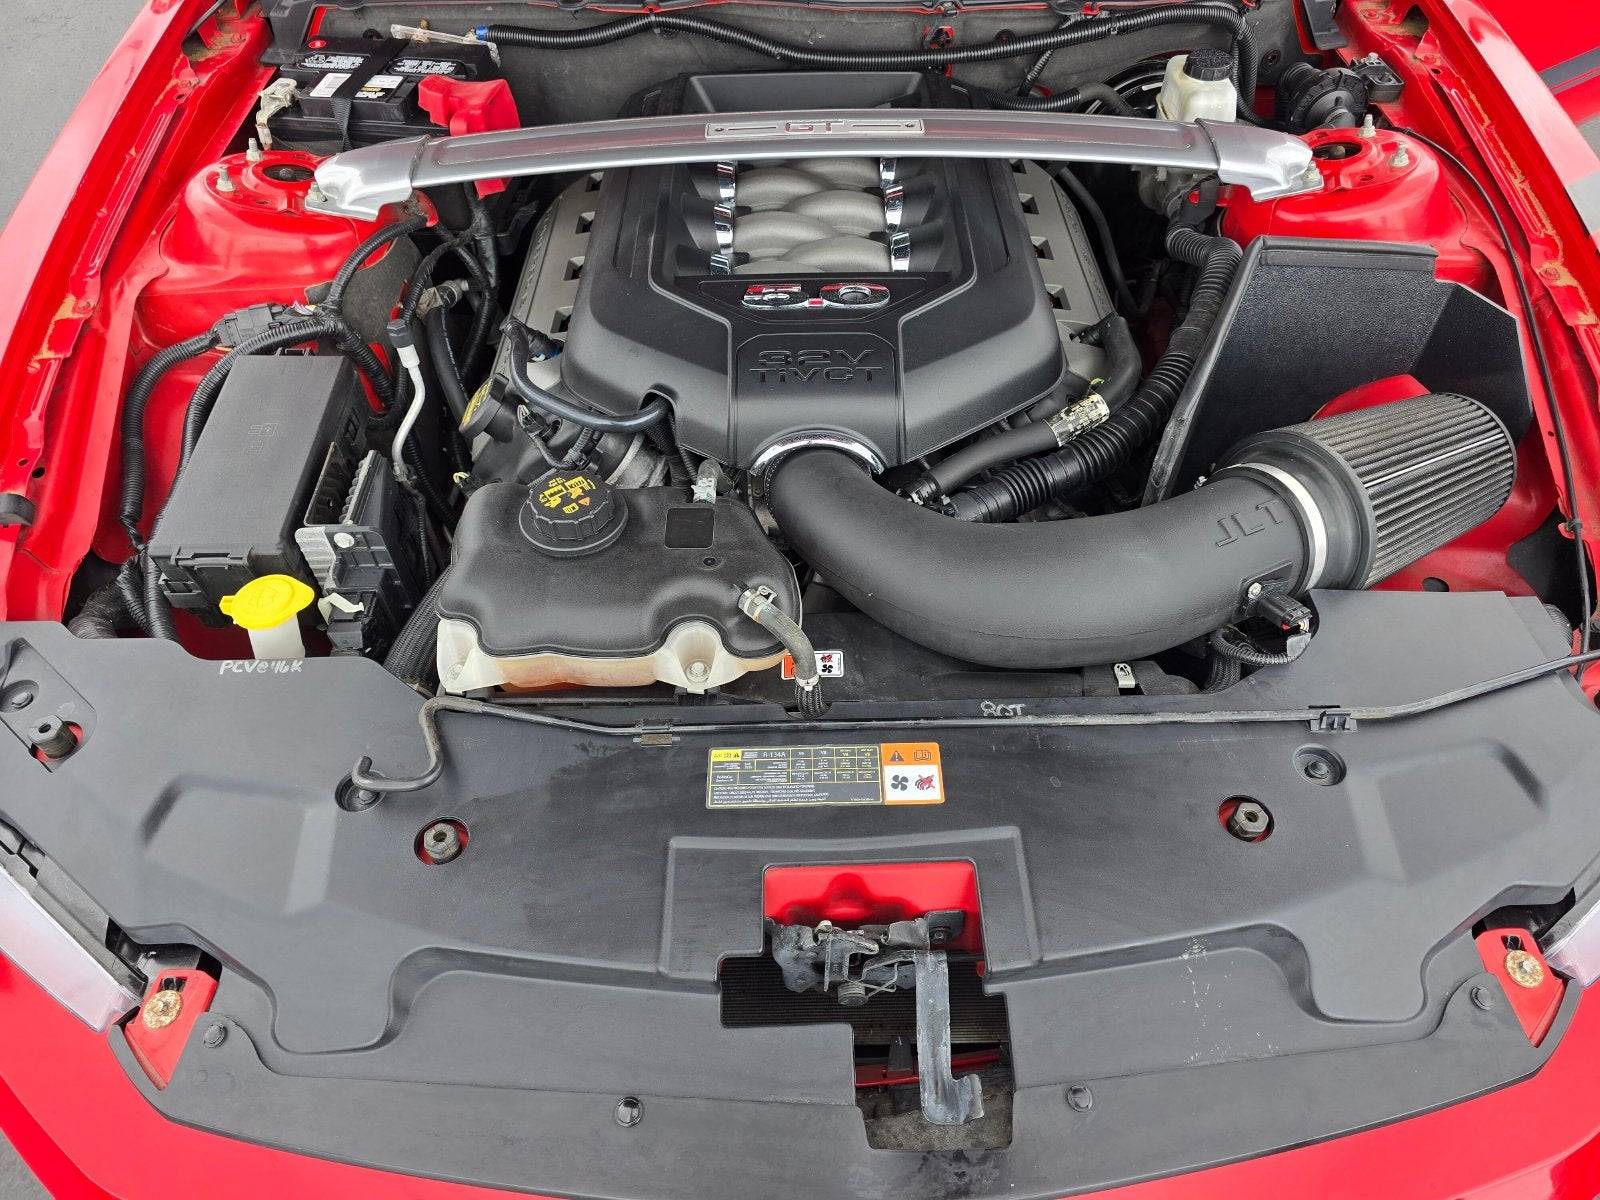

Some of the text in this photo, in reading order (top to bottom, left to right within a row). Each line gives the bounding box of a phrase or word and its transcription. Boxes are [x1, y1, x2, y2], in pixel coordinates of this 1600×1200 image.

[785, 120, 845, 133] GT
[741, 282, 891, 309] 5.0
[758, 349, 875, 366] 32V
[1215, 498, 1284, 548] JLT
